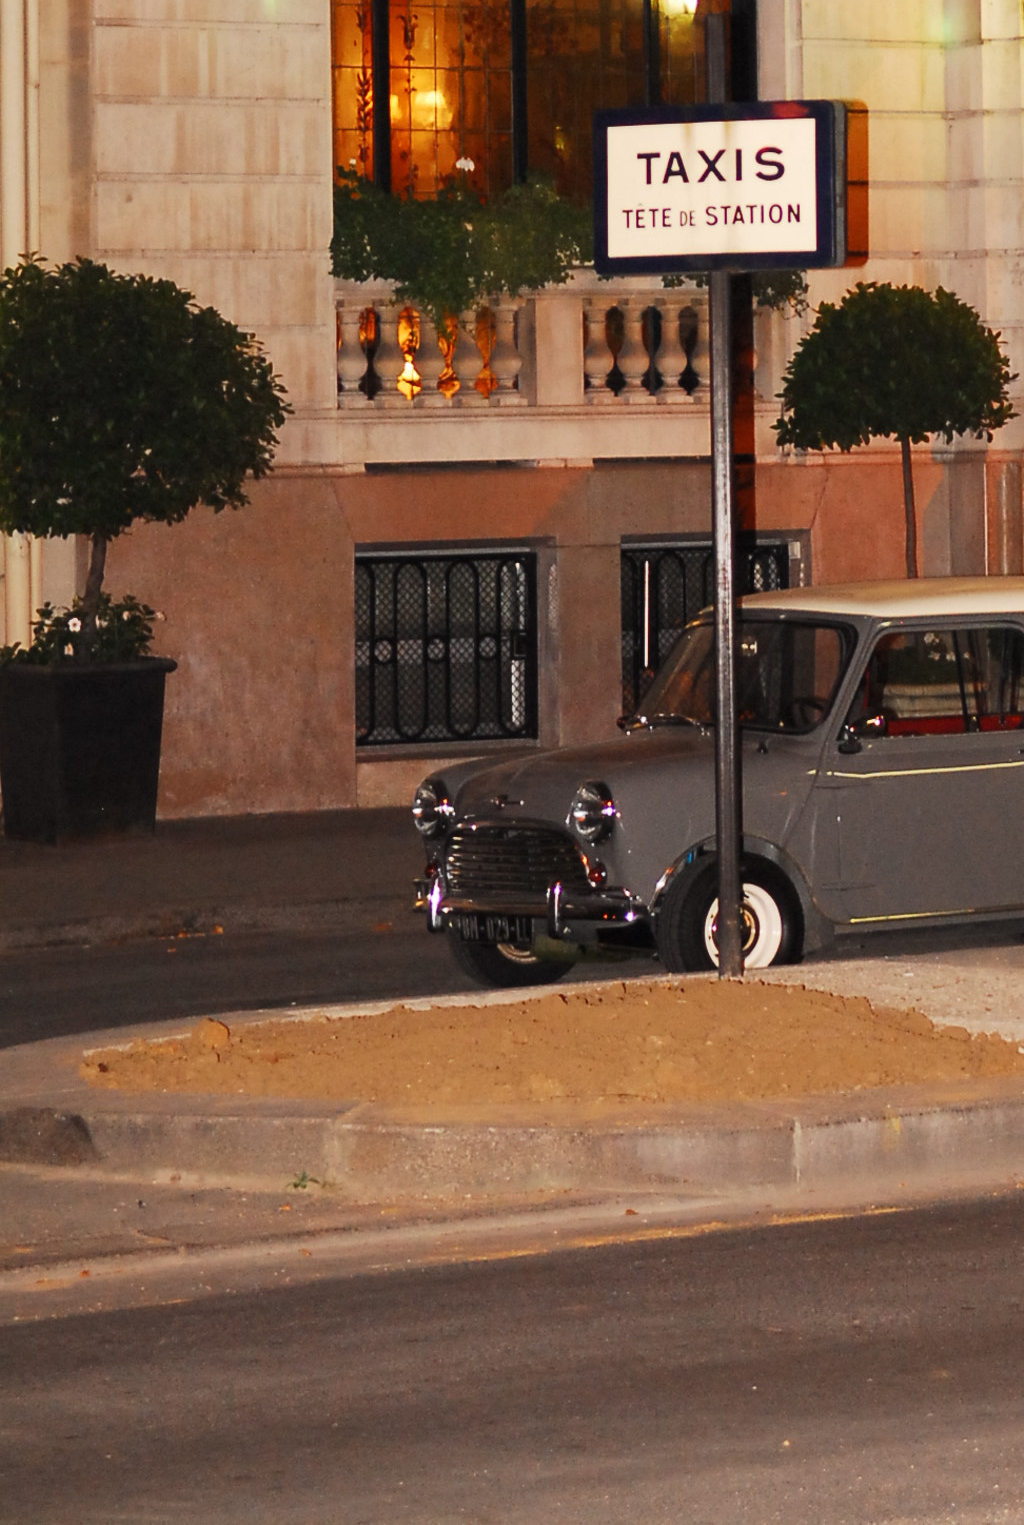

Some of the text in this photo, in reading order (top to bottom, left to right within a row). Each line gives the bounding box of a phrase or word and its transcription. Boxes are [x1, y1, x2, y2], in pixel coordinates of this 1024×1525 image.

[637, 146, 785, 185] TAXIS
[622, 203, 801, 228] TÊTE DE STATION
